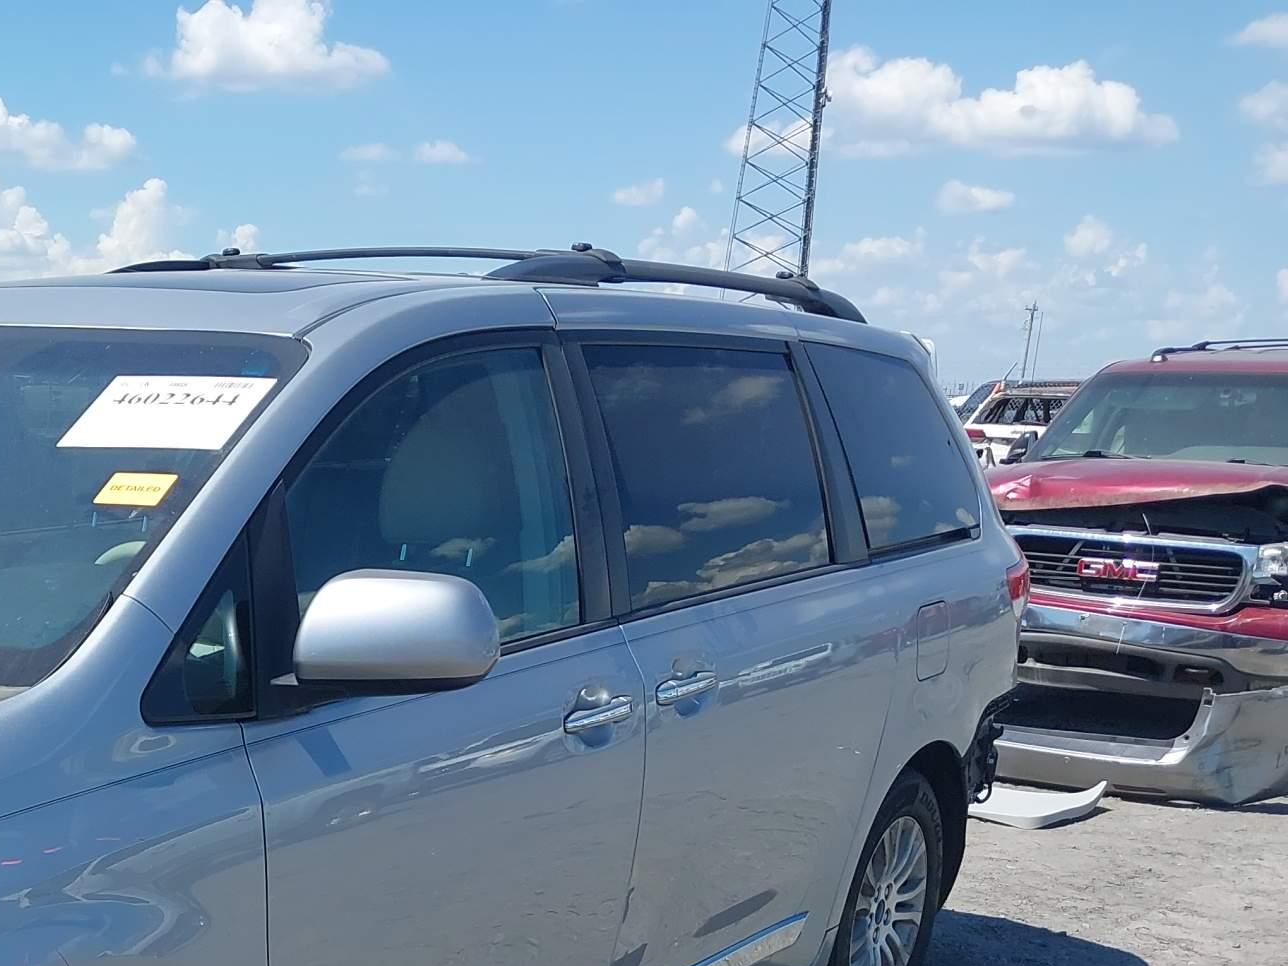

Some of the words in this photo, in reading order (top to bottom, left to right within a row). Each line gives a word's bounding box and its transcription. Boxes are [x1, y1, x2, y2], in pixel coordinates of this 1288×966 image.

[112, 392, 241, 405] 46022644
[109, 484, 161, 492] DETAILED
[1076, 557, 1160, 582] GMC
